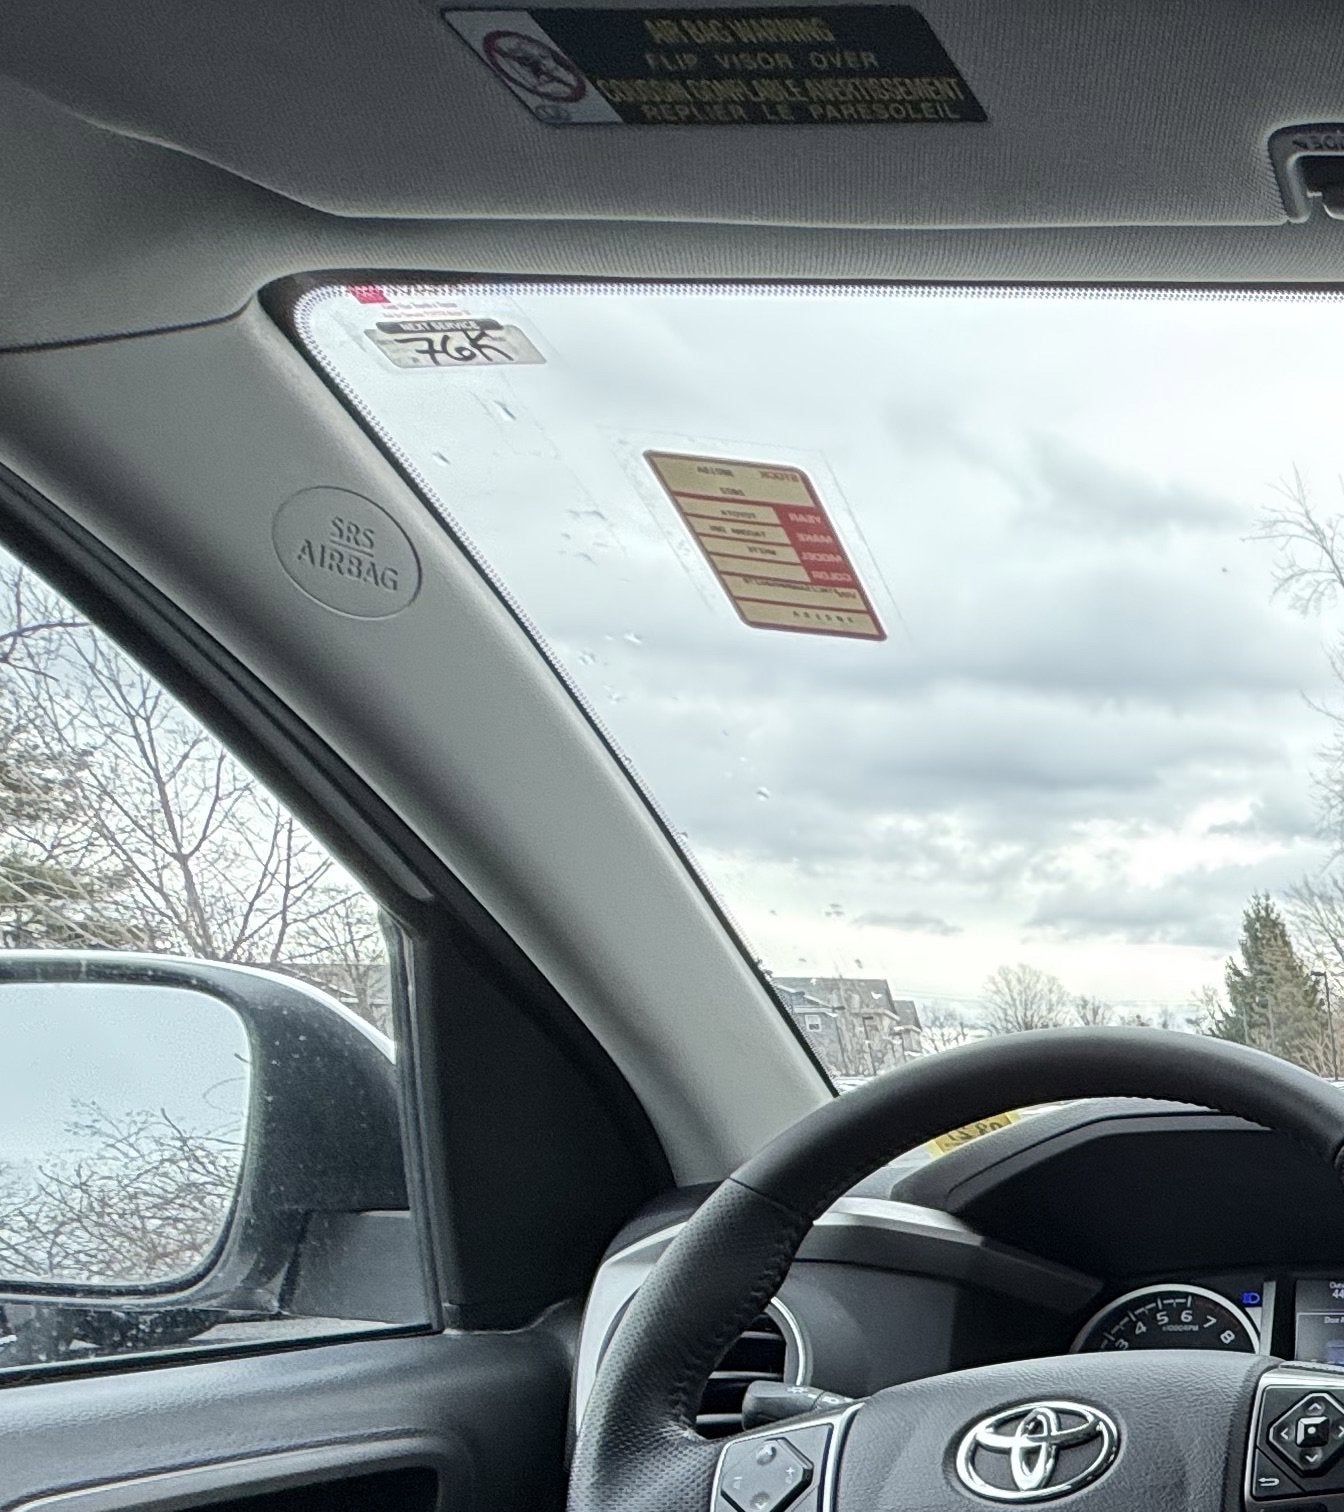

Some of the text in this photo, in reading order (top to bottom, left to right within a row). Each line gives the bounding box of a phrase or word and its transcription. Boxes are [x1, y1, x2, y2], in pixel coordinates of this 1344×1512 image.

[645, 16, 836, 44] AIR BAG WARNING
[645, 50, 879, 71] FLIP VISOR OVER
[803, 76, 965, 100] AVERTISSEMENT
[641, 102, 961, 120] REPLIER LE PARESOLEIL
[432, 320, 481, 331] SERVICE
[330, 516, 375, 551] SRS
[297, 538, 399, 591] AIRBAG
[1134, 1320, 1148, 1335] 4
[1156, 1311, 1169, 1326] 5
[1180, 1310, 1193, 1322] 6
[1202, 1315, 1217, 1329] 7
[1219, 1329, 1236, 1345] 8
